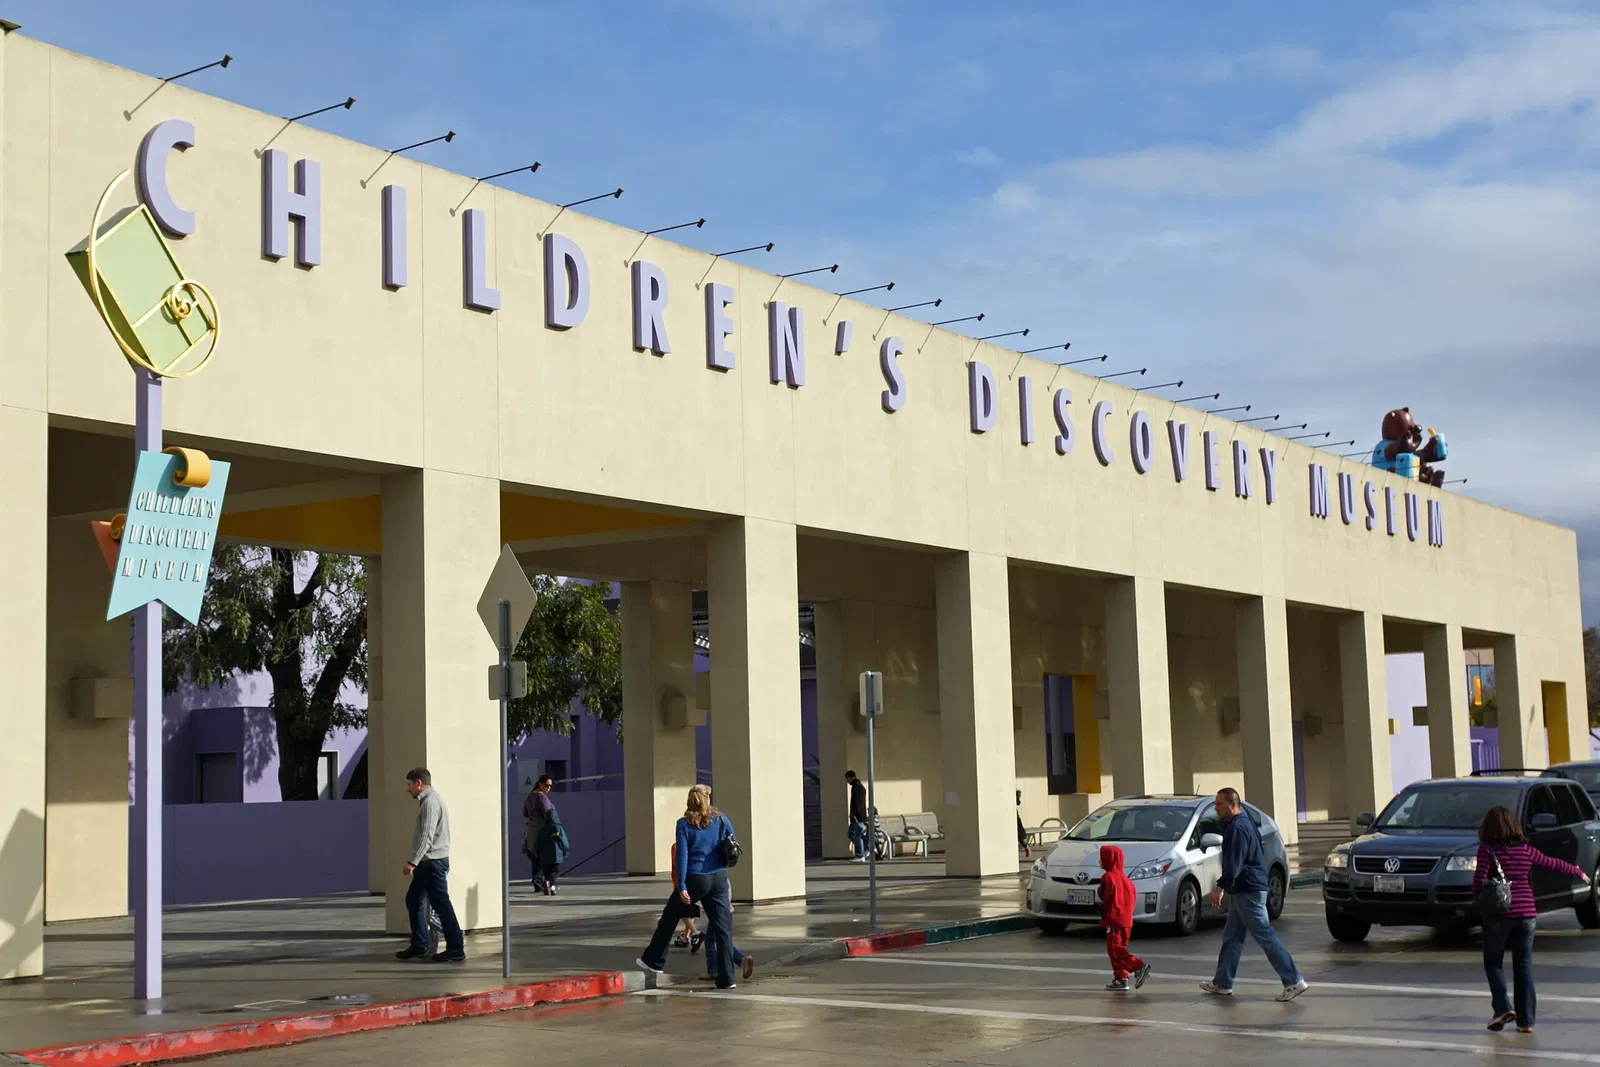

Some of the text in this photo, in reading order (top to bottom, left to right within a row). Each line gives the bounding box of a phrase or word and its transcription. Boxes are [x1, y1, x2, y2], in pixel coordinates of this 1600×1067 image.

[138, 119, 1444, 547] CHILDREN'S DISCOVERY MUSEUM
[136, 492, 216, 518] CHILDREN'S
[129, 524, 209, 550] DISCOVERY
[122, 557, 203, 582] MUSEUM
